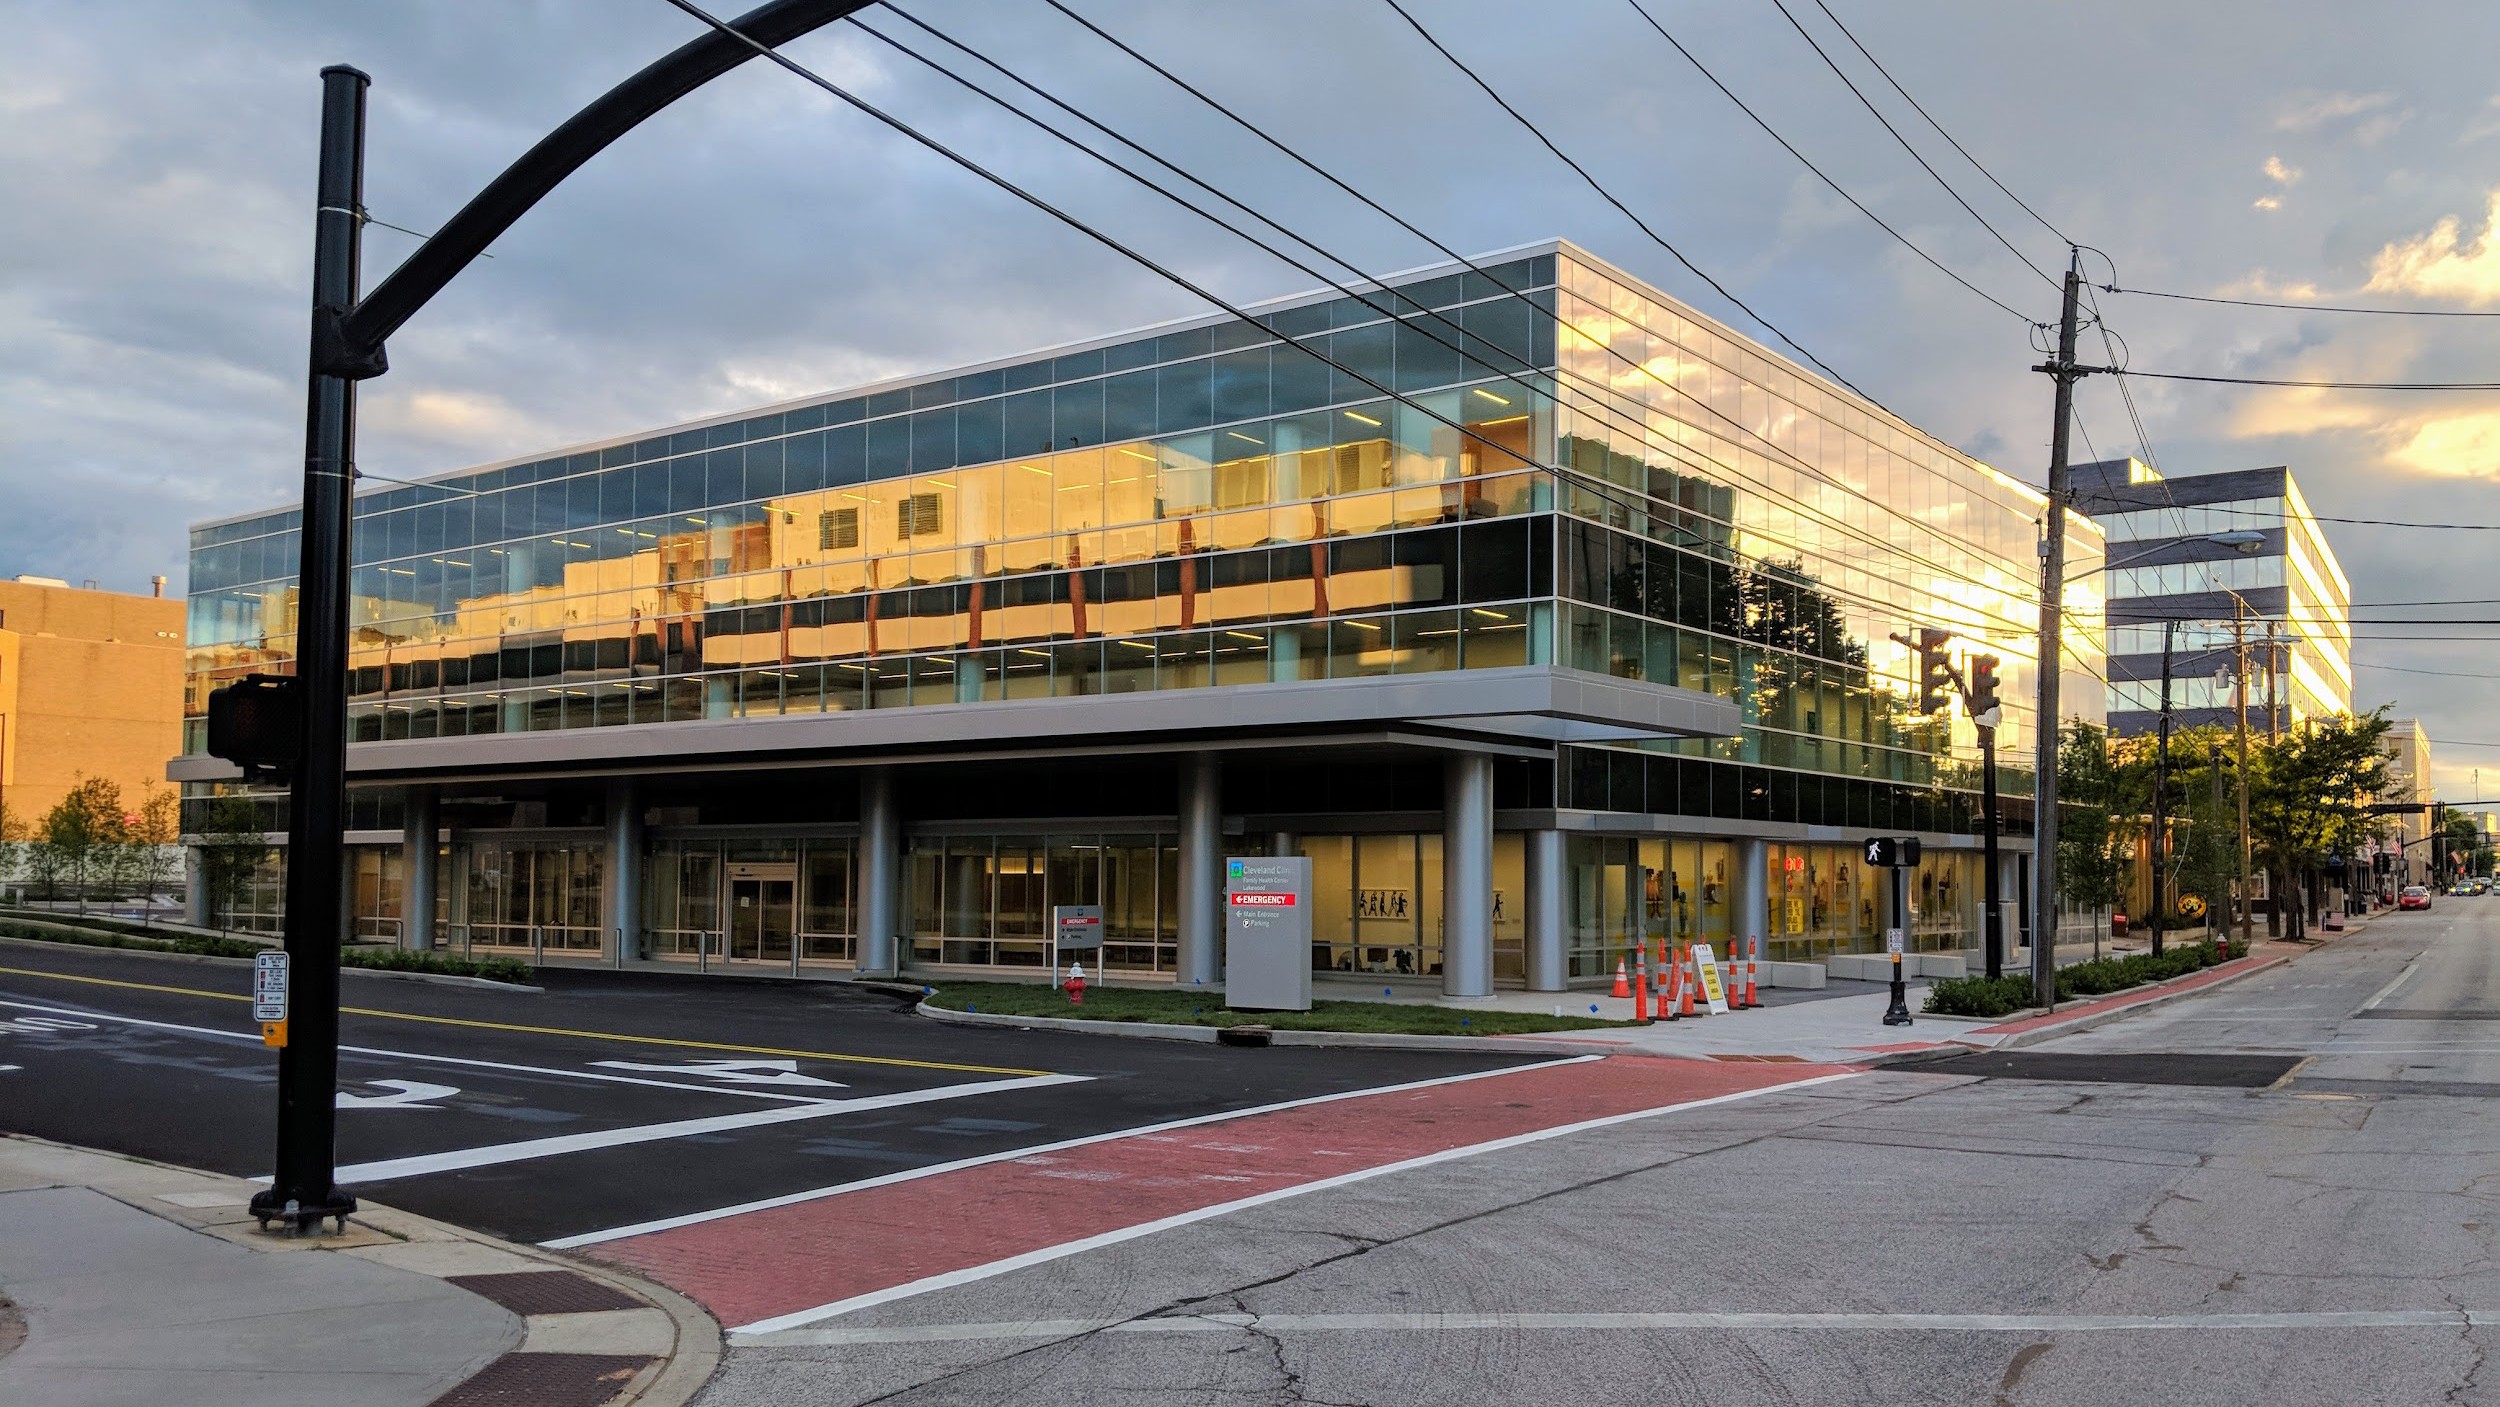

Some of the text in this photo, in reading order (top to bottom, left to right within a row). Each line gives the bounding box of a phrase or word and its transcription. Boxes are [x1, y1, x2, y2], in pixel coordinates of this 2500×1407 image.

[1243, 866, 1276, 874] Cleveland
[1243, 895, 1286, 904] EMERGENCY
[1243, 910, 1280, 918] Main Entrance
[1250, 920, 1270, 928] Parking
